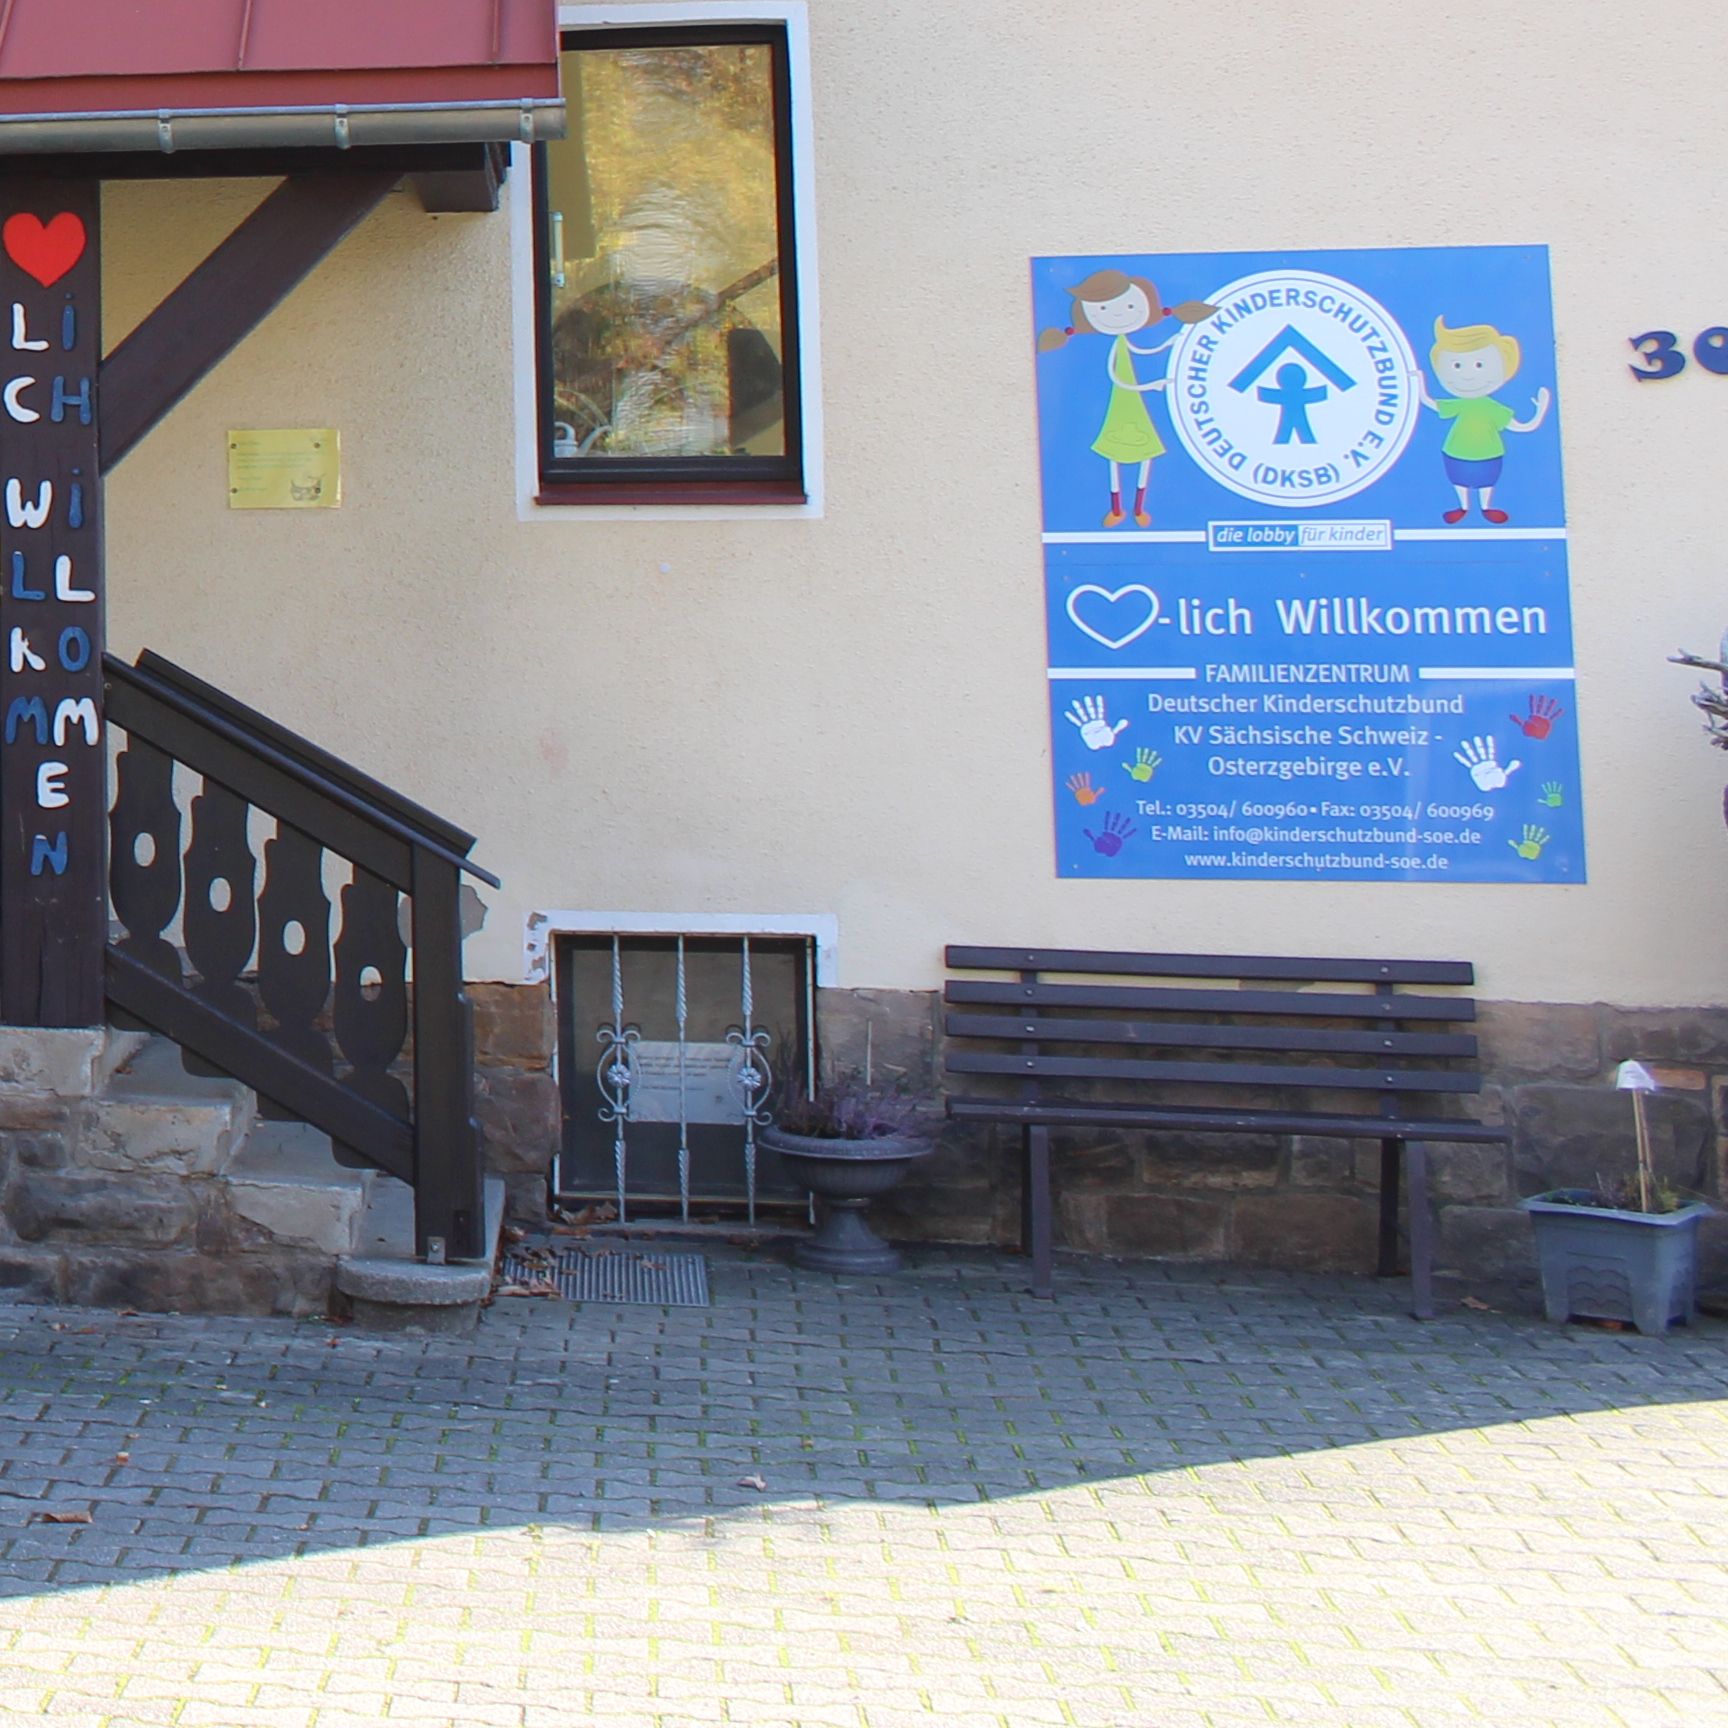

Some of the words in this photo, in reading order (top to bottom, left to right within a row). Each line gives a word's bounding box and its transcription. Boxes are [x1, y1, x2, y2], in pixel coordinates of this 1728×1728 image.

[1211, 287, 1398, 426] KINDERSCHUTZBUND
[1189, 336, 1248, 472] DEUTSCHER
[1252, 462, 1342, 490] (DKSB)
[1216, 526, 1242, 544] die
[1247, 525, 1296, 547] lobby
[1301, 525, 1325, 545] für
[1329, 524, 1385, 543] kinder
[1277, 598, 1548, 637] Willkommen
[1205, 663, 1411, 684] FAMILIENZENTRUM
[1148, 692, 1258, 714] Deutscher
[1263, 691, 1464, 715] Kinderschutzbund
[1174, 726, 1203, 745] KV
[1209, 723, 1332, 747] Sächsische
[1337, 723, 1430, 747] Schweiz
[1208, 756, 1363, 782] Osterzgebirge
[1368, 757, 1410, 778] e.V.
[1137, 800, 1171, 818] Tel.:
[1175, 801, 1237, 821] 03504/
[1241, 800, 1308, 819] 600960
[1321, 802, 1356, 819] Fax:
[1359, 801, 1422, 821] 03504/
[1427, 801, 1495, 821] 600969
[1151, 826, 1209, 844] E-Mail:
[1213, 826, 1482, 848] info@kinderschutzbund-soe.de
[1184, 852, 1449, 873] www.kinderschutzbund-soe.de
